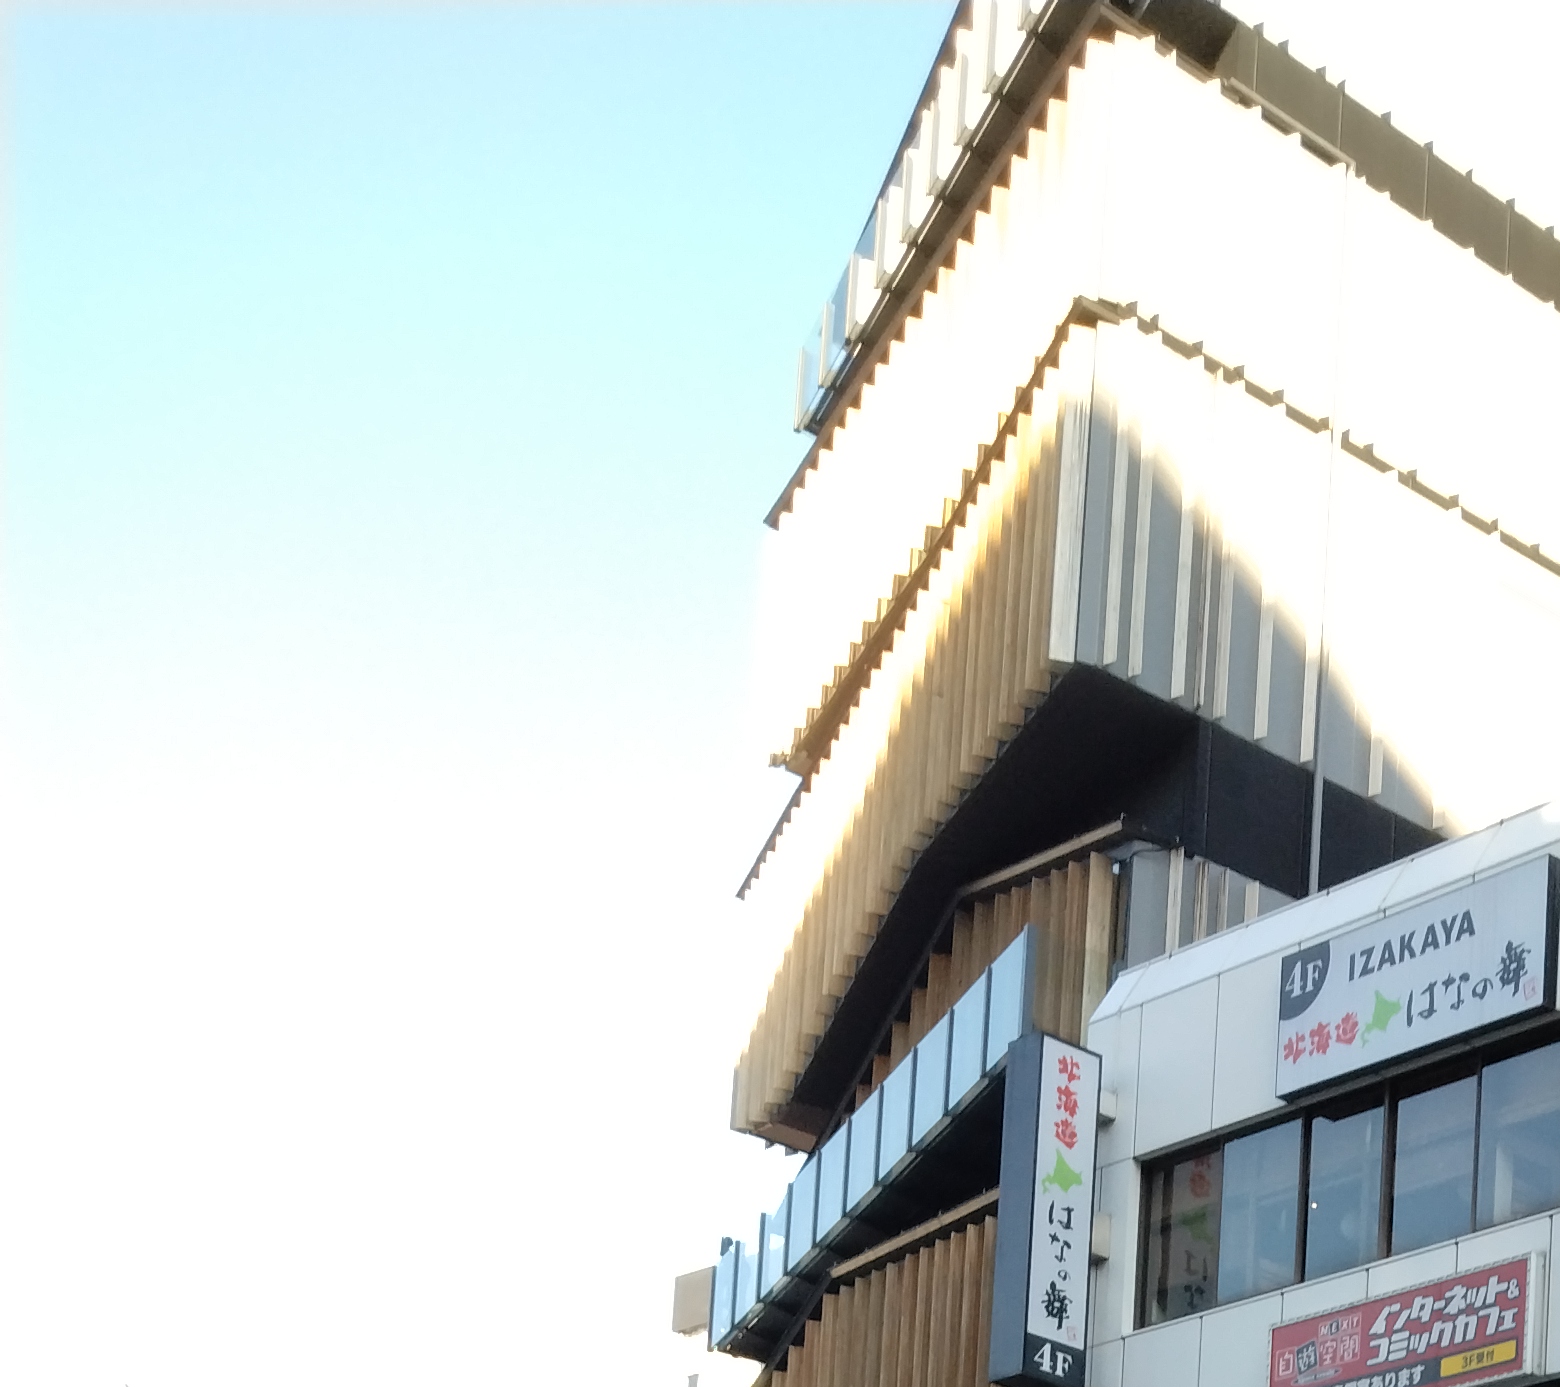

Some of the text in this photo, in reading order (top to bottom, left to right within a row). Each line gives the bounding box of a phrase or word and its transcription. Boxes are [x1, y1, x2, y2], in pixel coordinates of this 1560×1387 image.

[1349, 909, 1476, 982] IZAKAYA
[1285, 960, 1322, 998] 4F
[1320, 1316, 1360, 1337] NEXT
[1366, 1307, 1519, 1366] コミックカフェ
[1034, 1342, 1073, 1378] 4F
